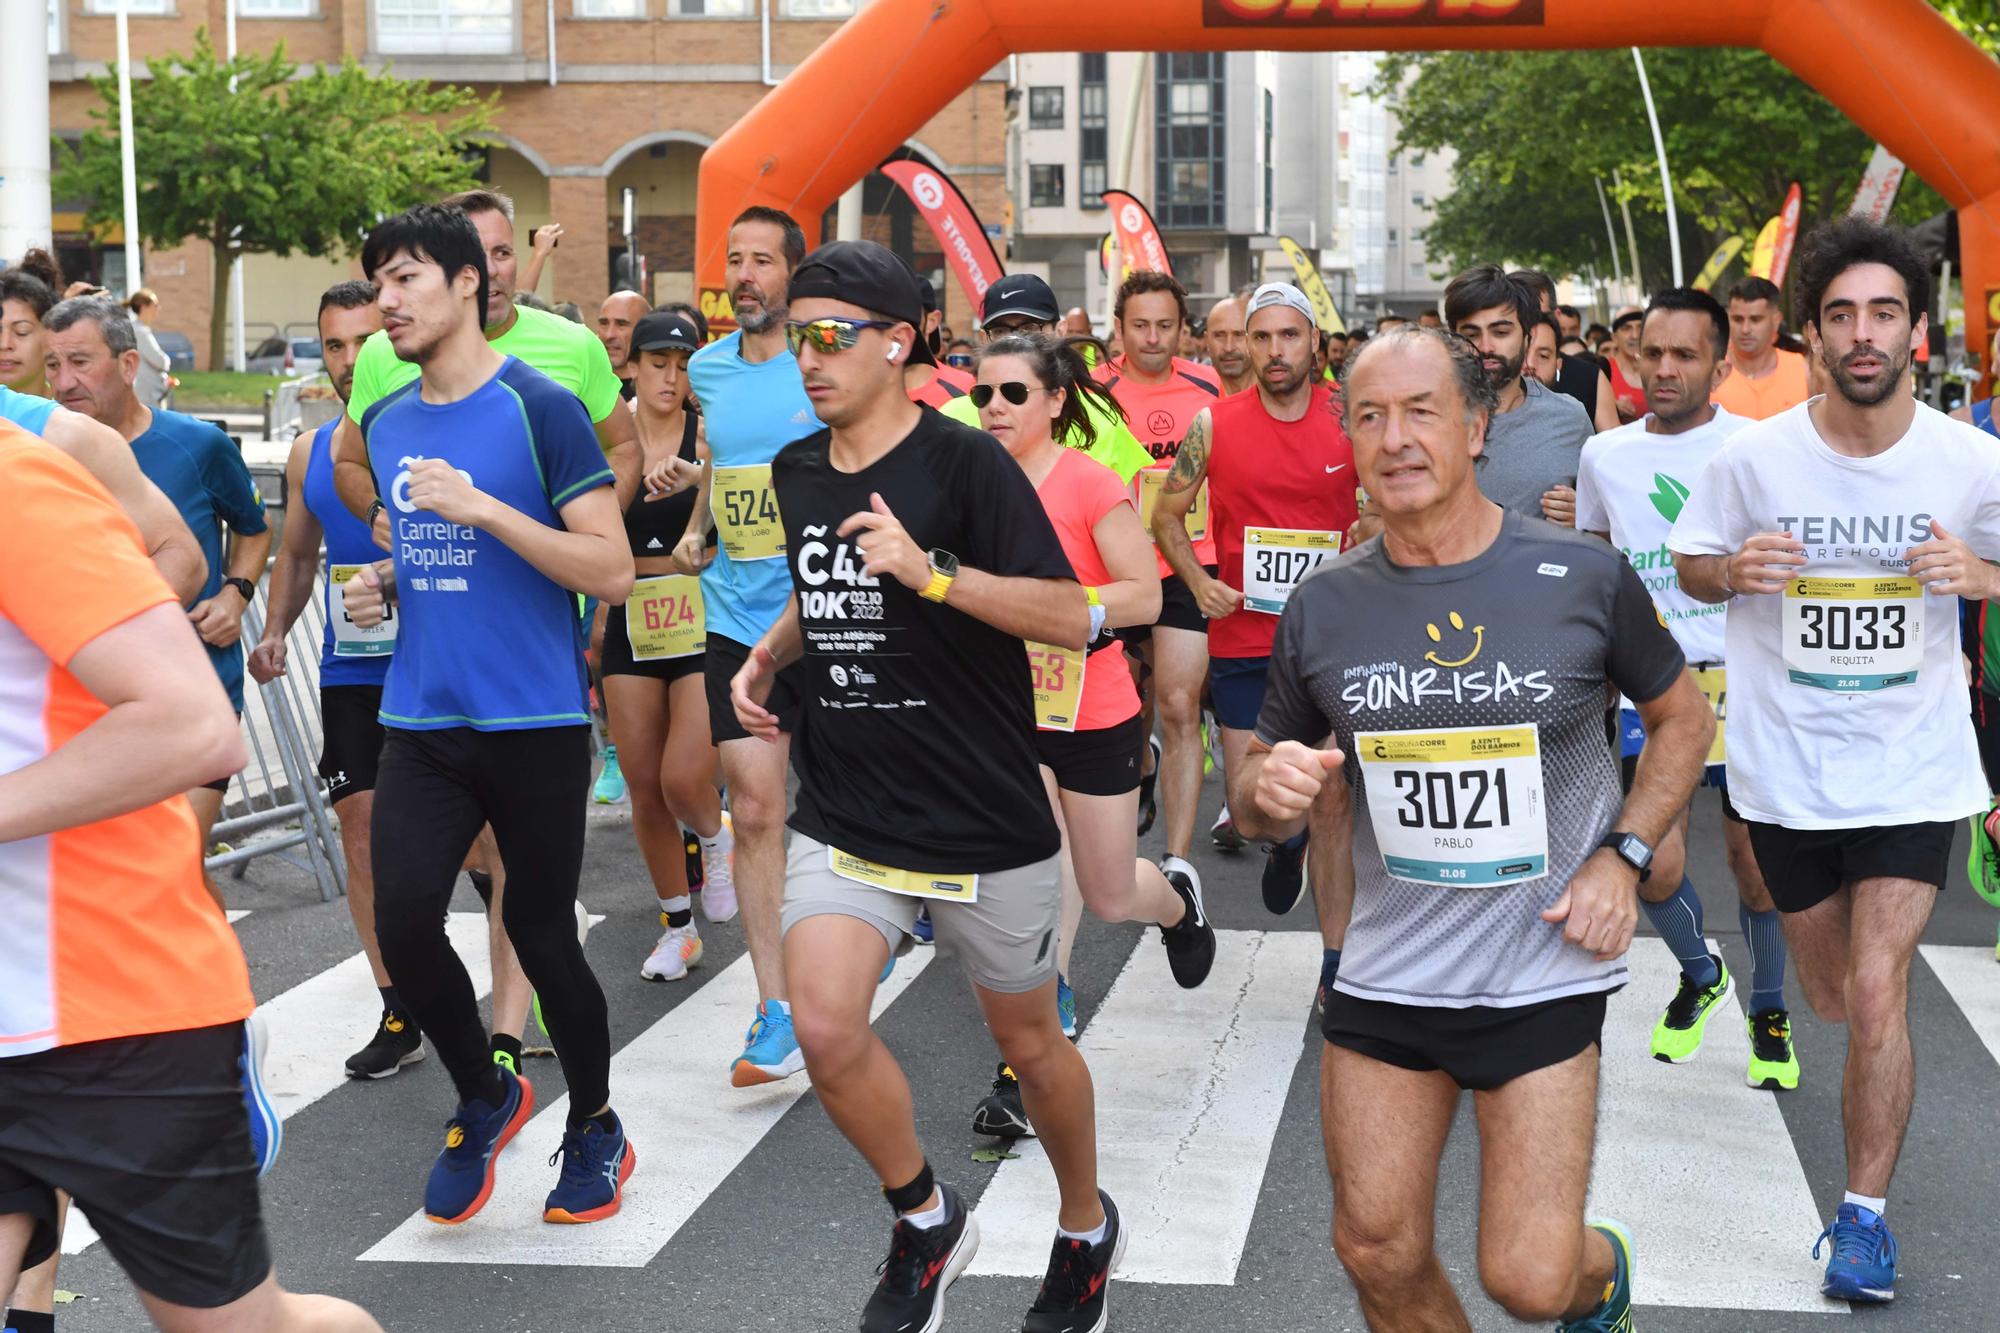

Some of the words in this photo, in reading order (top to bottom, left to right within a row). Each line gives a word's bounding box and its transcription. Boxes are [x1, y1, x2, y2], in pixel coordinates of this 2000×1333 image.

[725, 488, 777, 526] 524
[399, 518, 476, 540] Carreira
[1777, 513, 1932, 544] TENNIS
[401, 543, 477, 572] Popular
[643, 594, 695, 630] 624
[800, 591, 849, 619] 10K
[849, 591, 883, 605] 02.10
[850, 605, 884, 619] 2022
[1800, 605, 1906, 650] 3033
[1830, 655, 1875, 666] REQUITA
[1341, 661, 1554, 714] SONRISAS
[1394, 768, 1510, 829] 3021
[1434, 837, 1473, 849] PABLO
[1440, 868, 1466, 879] 21.05
